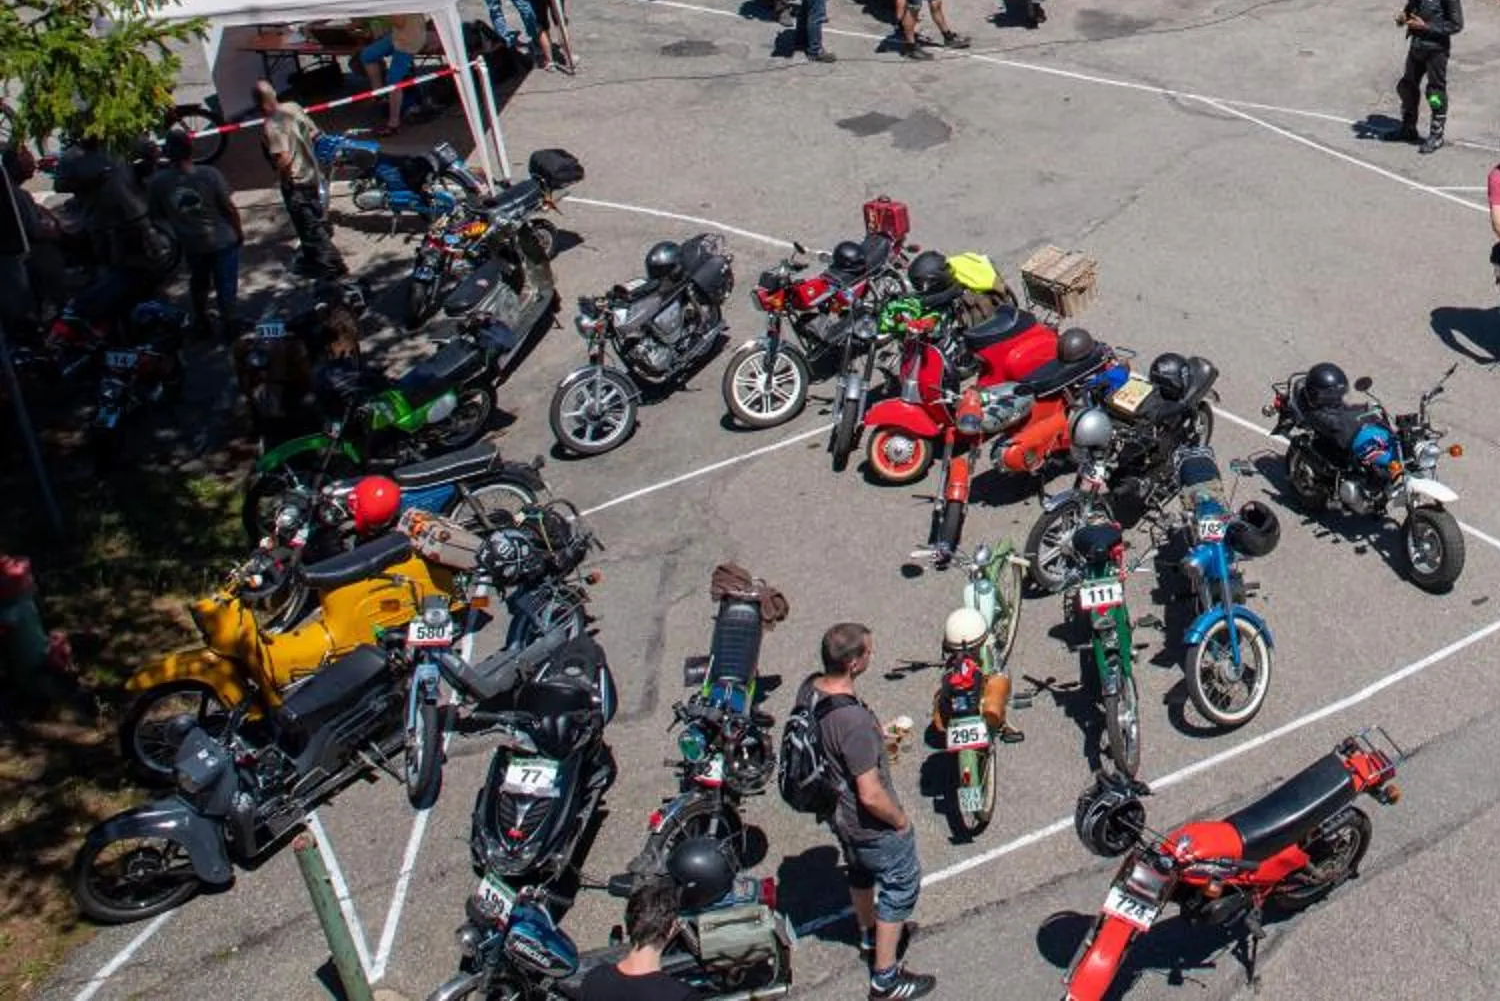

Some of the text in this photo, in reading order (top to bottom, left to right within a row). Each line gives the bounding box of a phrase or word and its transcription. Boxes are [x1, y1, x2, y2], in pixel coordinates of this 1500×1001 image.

[1089, 588, 1113, 603] 111
[416, 626, 446, 640] 580
[951, 726, 980, 744] 295
[520, 769, 544, 784] 77
